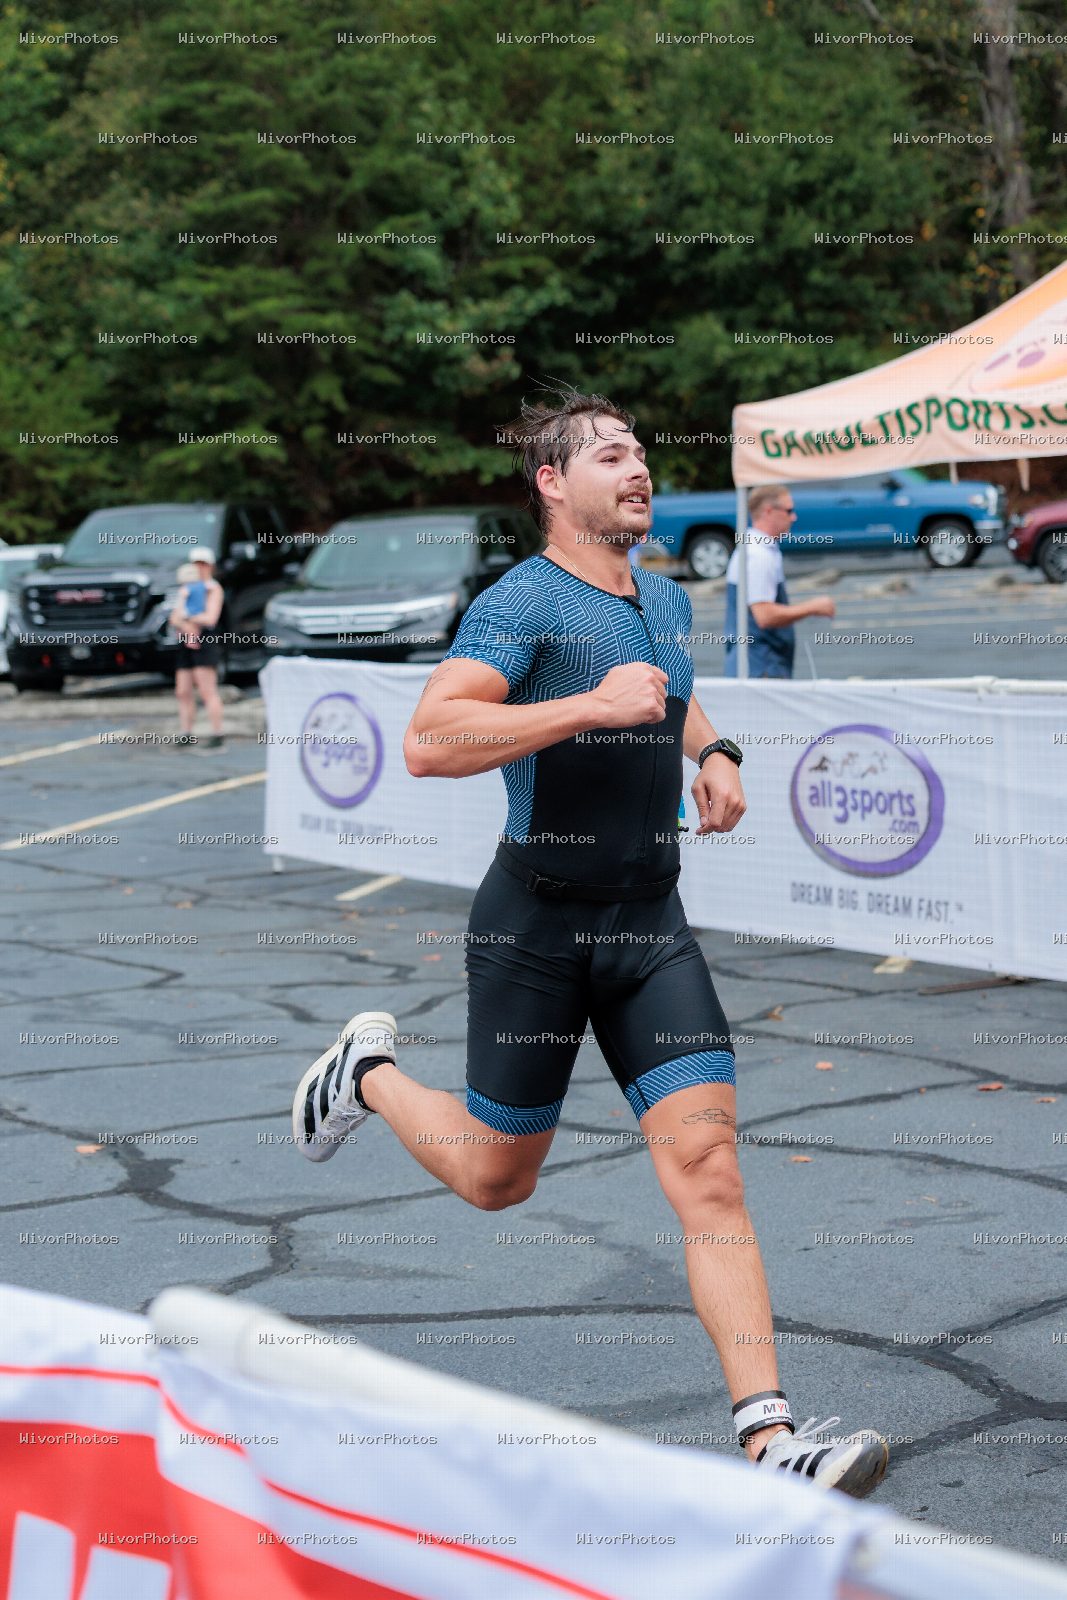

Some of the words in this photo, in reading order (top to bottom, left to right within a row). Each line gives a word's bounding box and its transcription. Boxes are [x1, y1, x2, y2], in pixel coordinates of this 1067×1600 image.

[760, 396, 1067, 459] GAMULTISPORTS.C
[808, 780, 916, 824] all3sports
[790, 881, 833, 907] DREAM
[867, 891, 912, 918] DREAM
